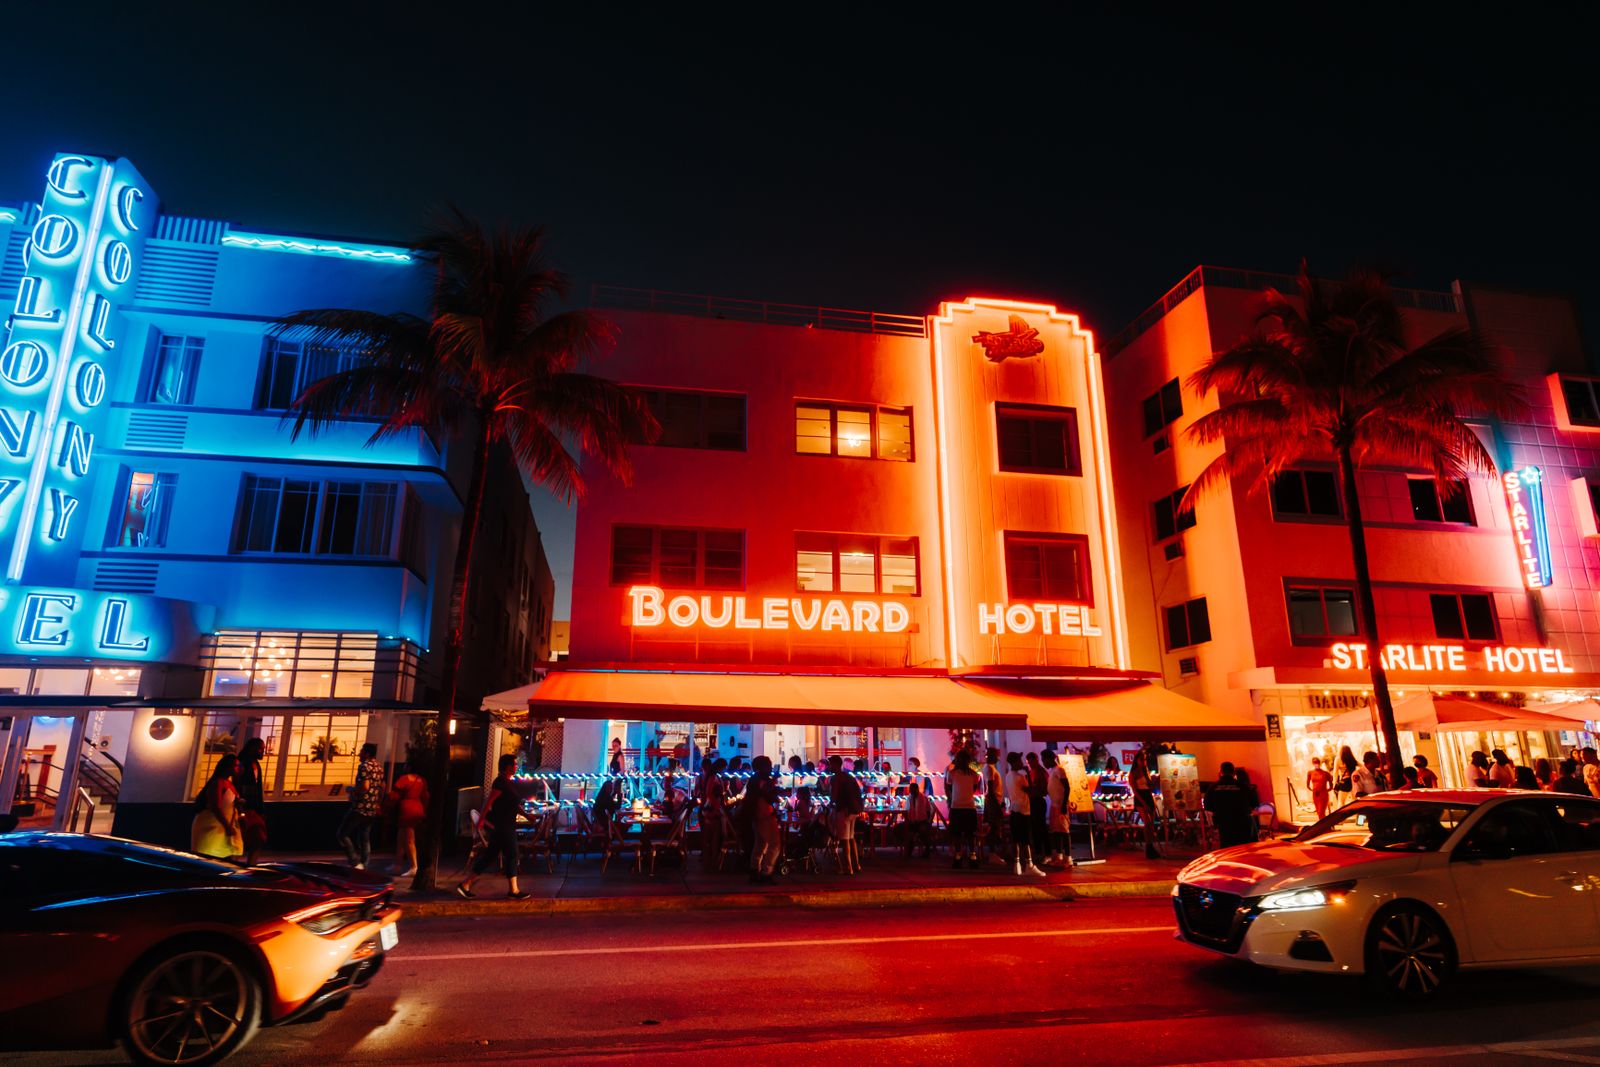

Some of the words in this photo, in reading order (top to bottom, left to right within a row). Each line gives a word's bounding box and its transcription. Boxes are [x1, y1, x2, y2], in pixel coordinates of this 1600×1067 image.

[49, 184, 143, 542] COLONY
[1503, 471, 1543, 588] STARLITE
[16, 592, 149, 651] EL
[628, 585, 910, 634] BOULEVARD
[978, 602, 1103, 637] HOTEL
[1485, 647, 1575, 674] HOTEL
